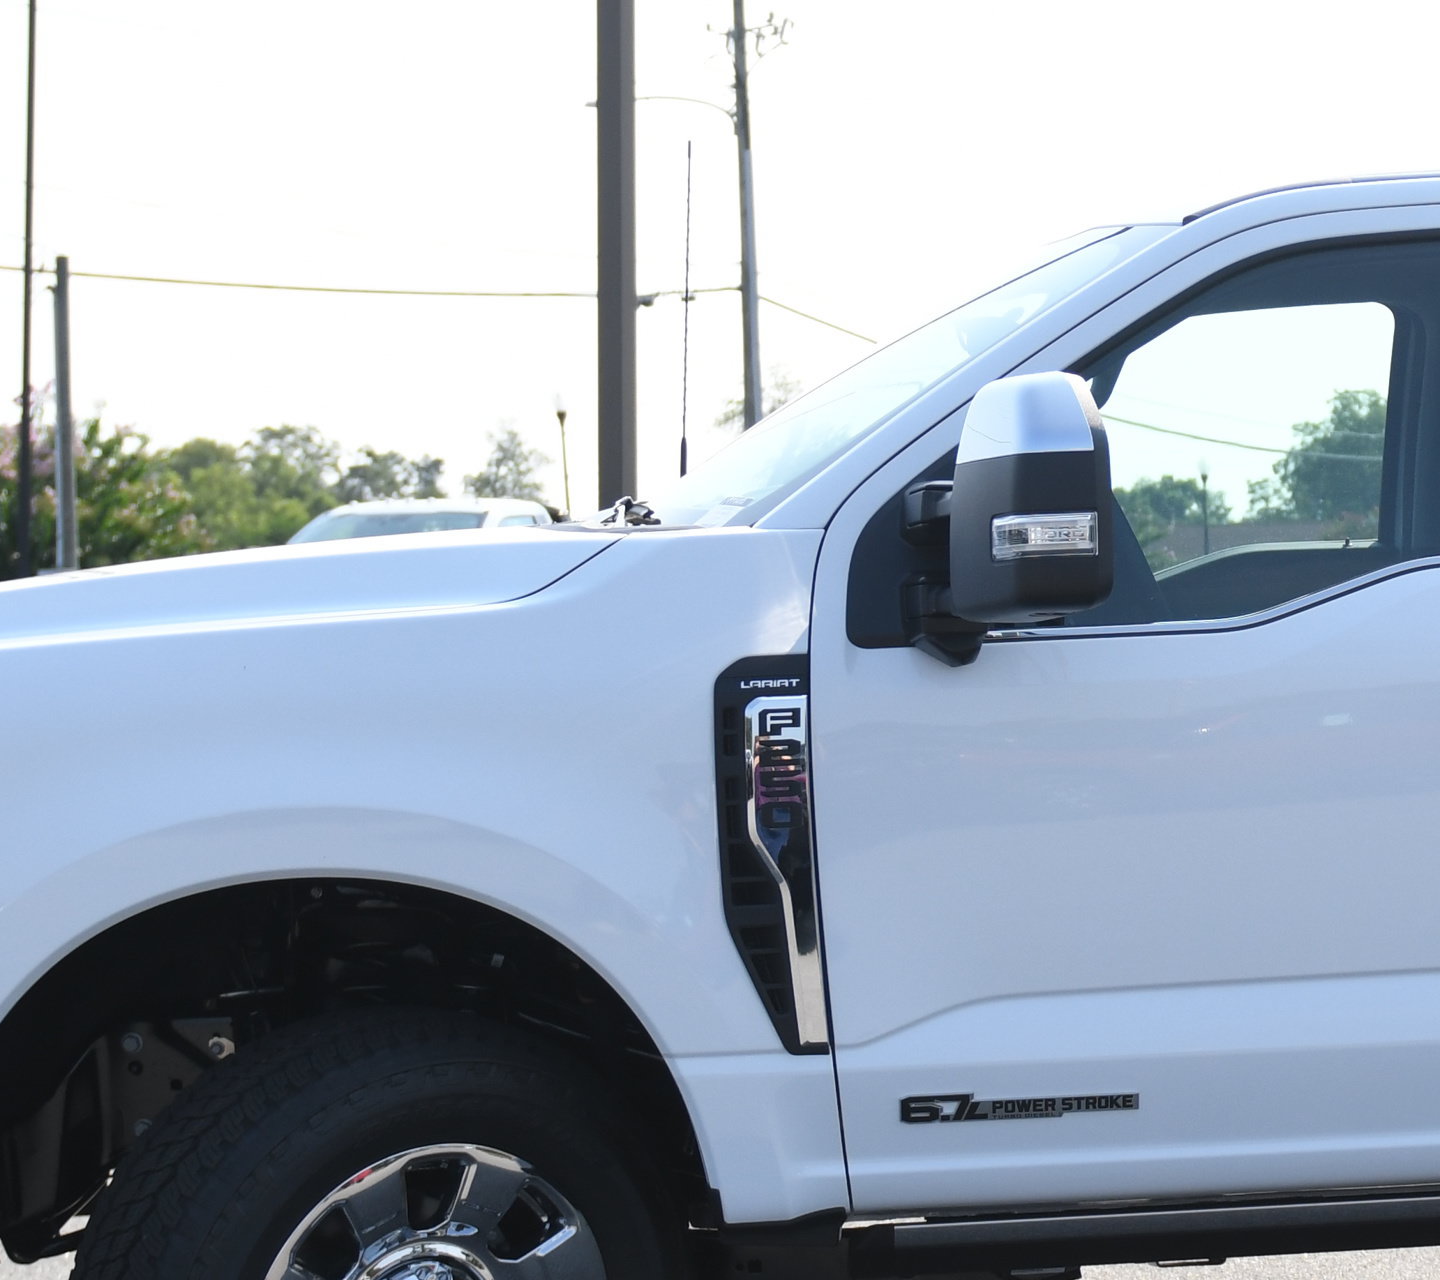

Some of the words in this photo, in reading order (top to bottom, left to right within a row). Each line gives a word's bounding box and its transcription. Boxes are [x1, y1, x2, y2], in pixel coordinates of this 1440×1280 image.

[740, 678, 801, 689] LARIAT
[991, 1097, 1057, 1114] POWER
[1061, 1094, 1134, 1111] STROKE
